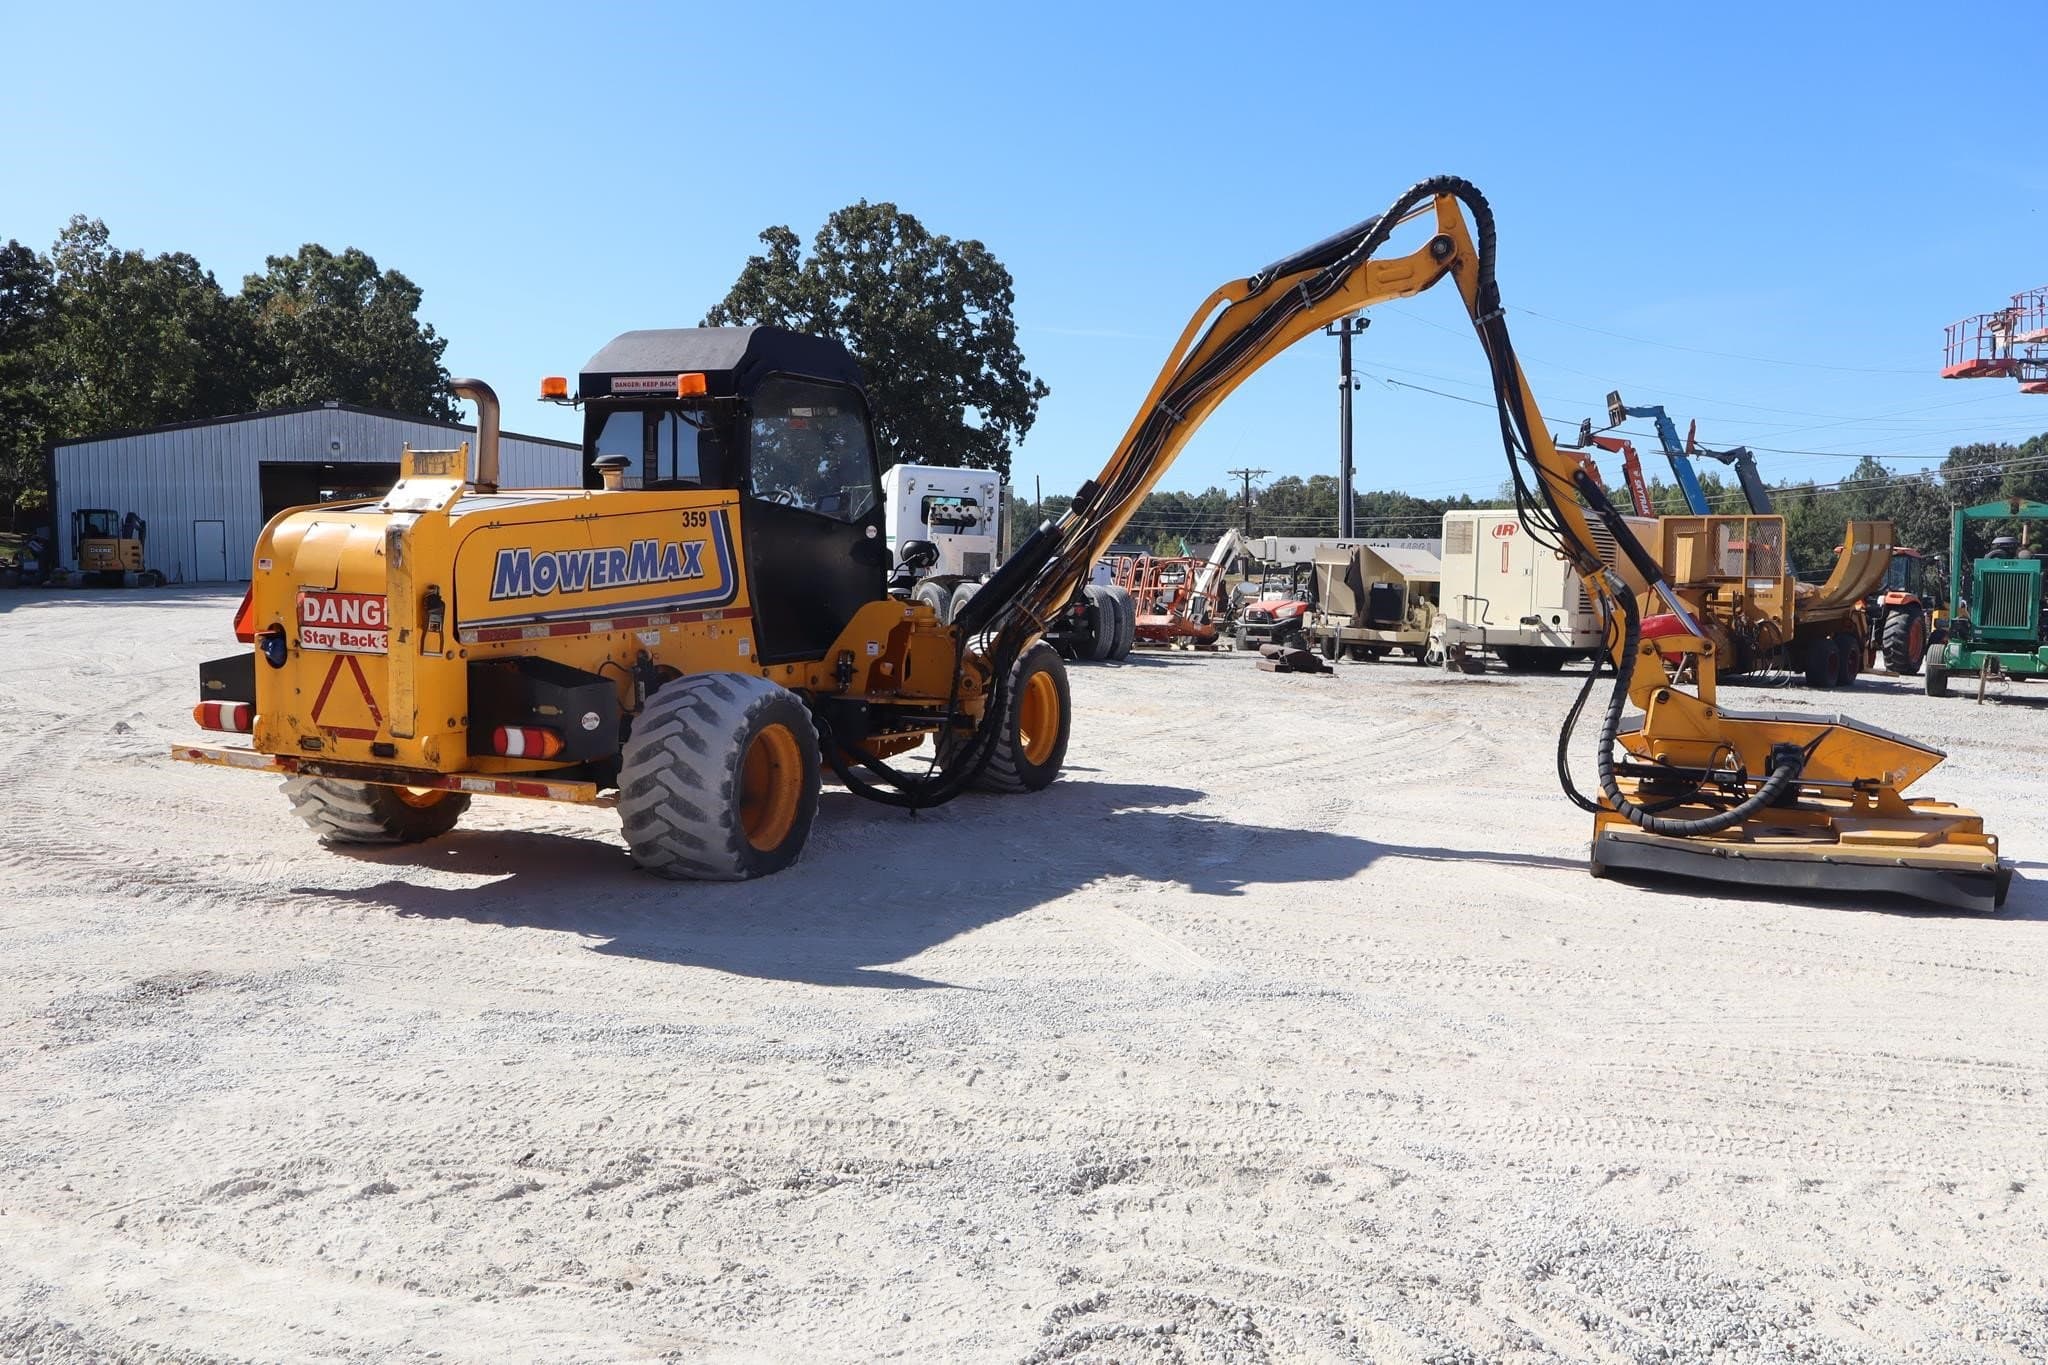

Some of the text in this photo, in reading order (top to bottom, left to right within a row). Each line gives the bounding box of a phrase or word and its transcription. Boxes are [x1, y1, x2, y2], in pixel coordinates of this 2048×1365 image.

[642, 380, 658, 388] KEEP
[682, 511, 707, 528] 359
[303, 629, 335, 648] Stay
[340, 631, 378, 648] Back
